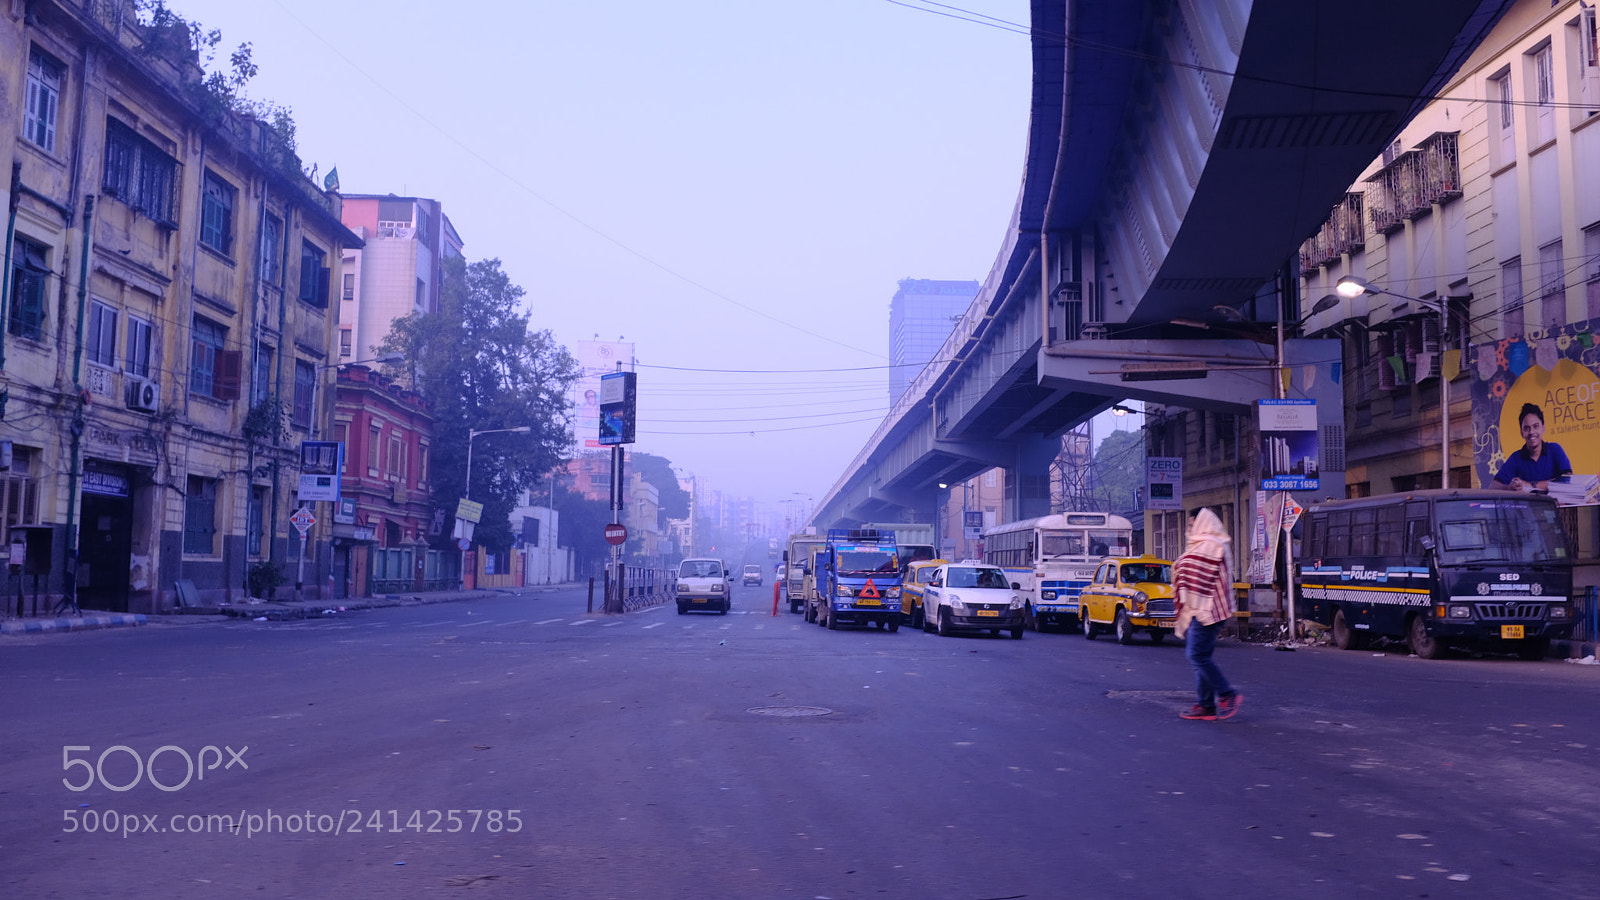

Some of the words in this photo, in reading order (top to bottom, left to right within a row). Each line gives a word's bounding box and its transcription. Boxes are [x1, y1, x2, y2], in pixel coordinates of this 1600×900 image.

[1553, 402, 1596, 424] PACE
[1557, 424, 1580, 434] talent
[1150, 460, 1181, 469] ZERO
[1160, 472, 1166, 480] 7
[1264, 480, 1278, 489] 033
[1279, 480, 1298, 489] 3087
[1300, 480, 1318, 488] 1656
[605, 530, 611, 538] NO
[611, 529, 625, 537] ENTRY
[1350, 570, 1378, 581] POLICE
[1499, 573, 1520, 581] SED
